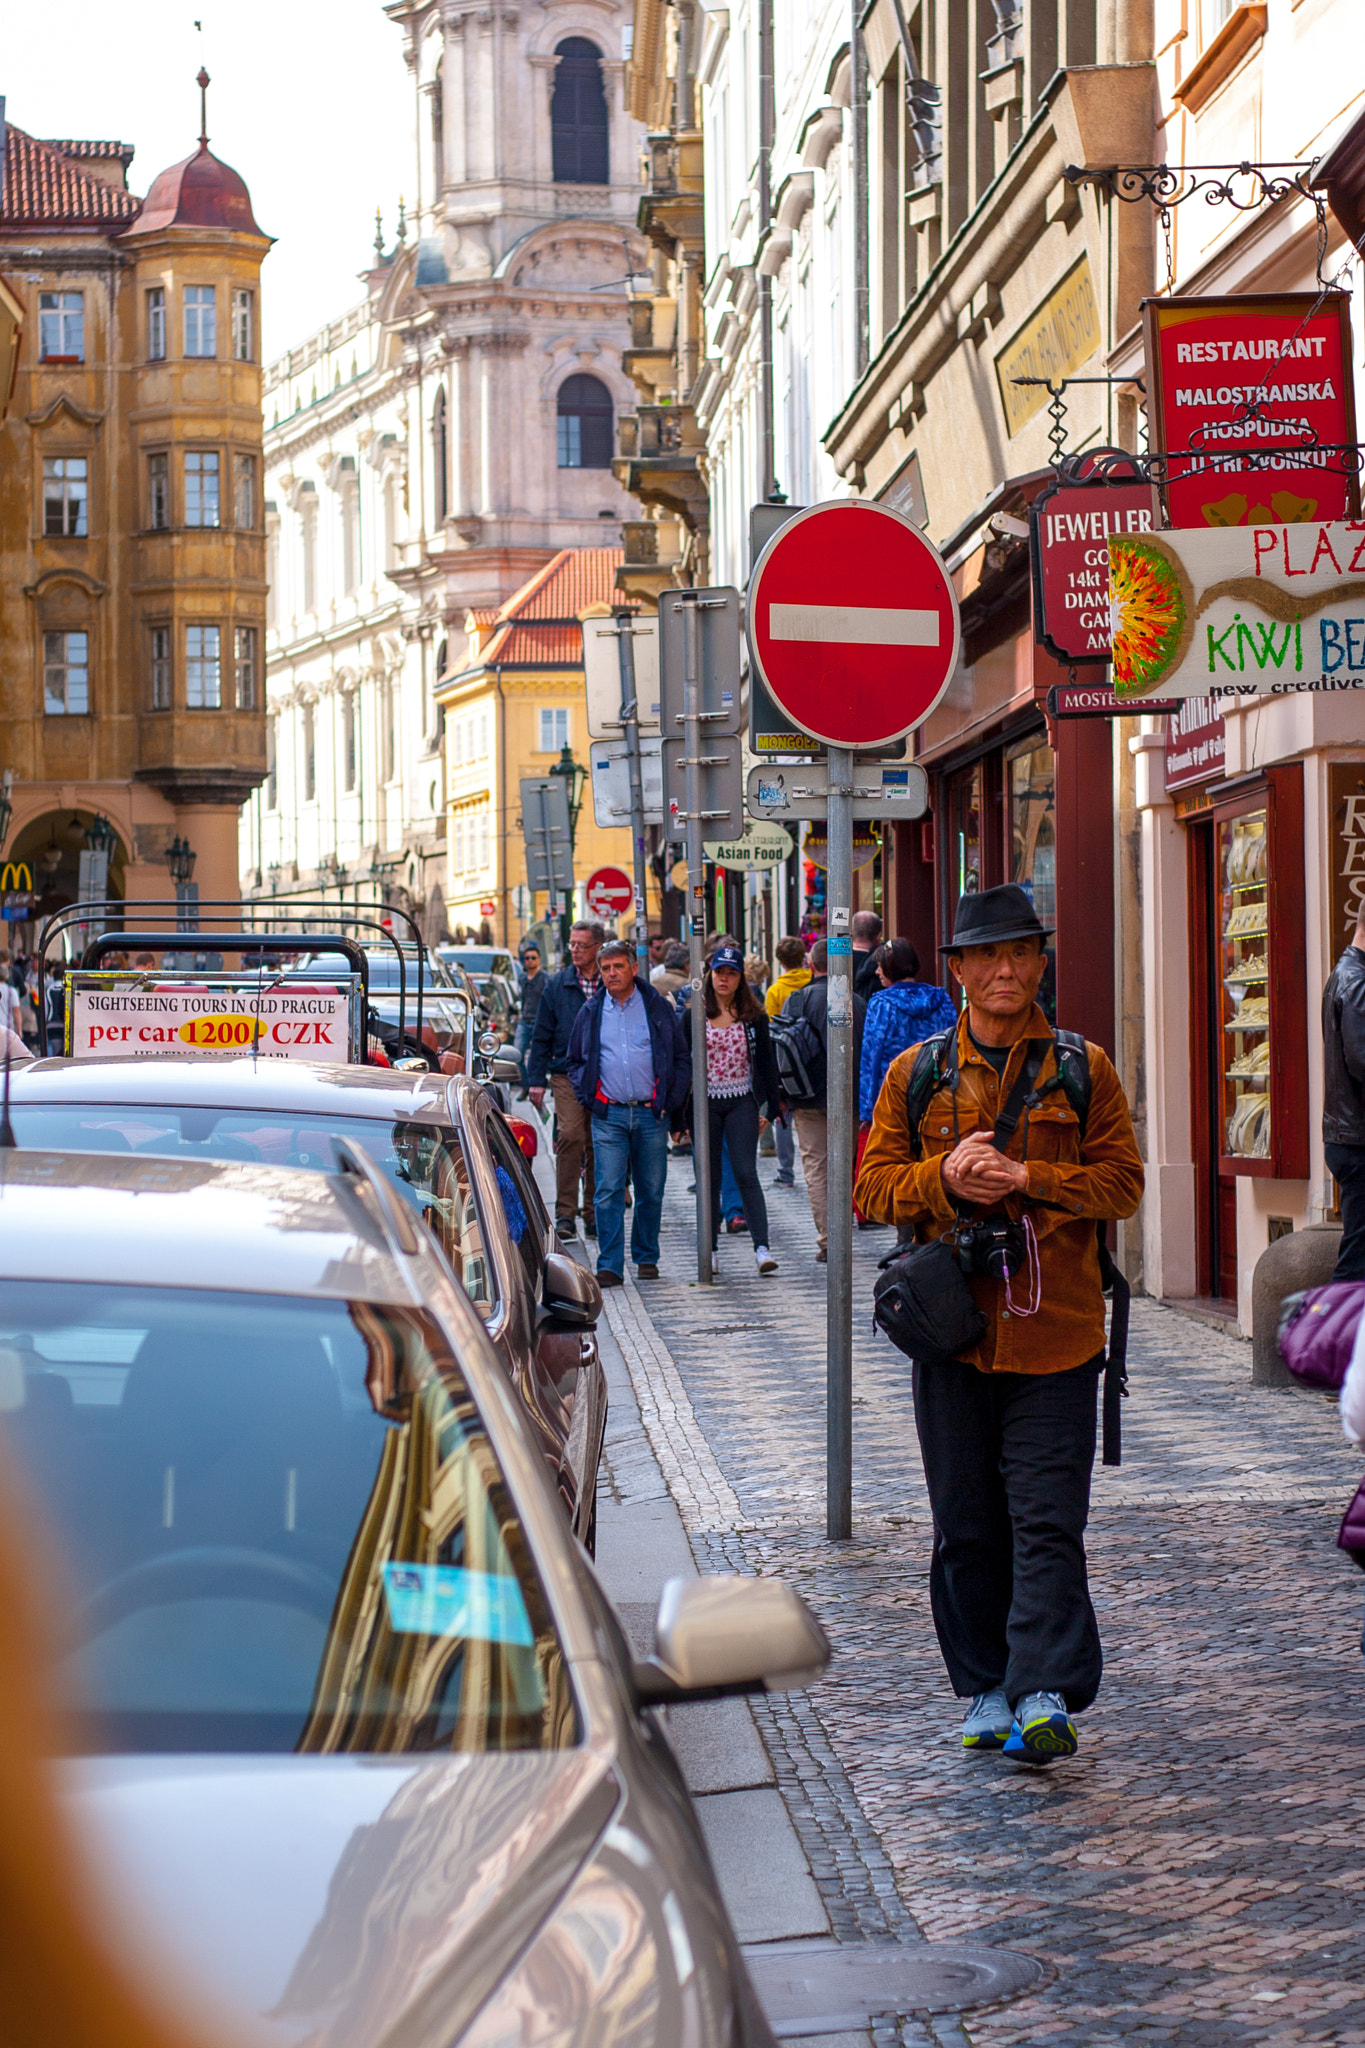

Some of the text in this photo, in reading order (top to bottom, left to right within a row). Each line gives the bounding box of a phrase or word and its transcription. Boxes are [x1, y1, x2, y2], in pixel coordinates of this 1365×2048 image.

[1066, 277, 1096, 350] SHOP
[1177, 337, 1326, 363] RESTAURANT
[1175, 378, 1336, 406] MALOSTRANSKÁ
[1046, 509, 1152, 548] JEWELLER
[1067, 569, 1101, 588] 14kt
[1320, 618, 1365, 673] BE
[1209, 674, 1364, 696] new creative
[717, 846, 783, 860] Asian Food
[88, 996, 335, 1014] SIGHTSEEING TOURS IN OLD PRAGUE
[88, 1025, 132, 1048] per
[138, 1026, 178, 1042] car
[272, 1022, 334, 1045] CZK
